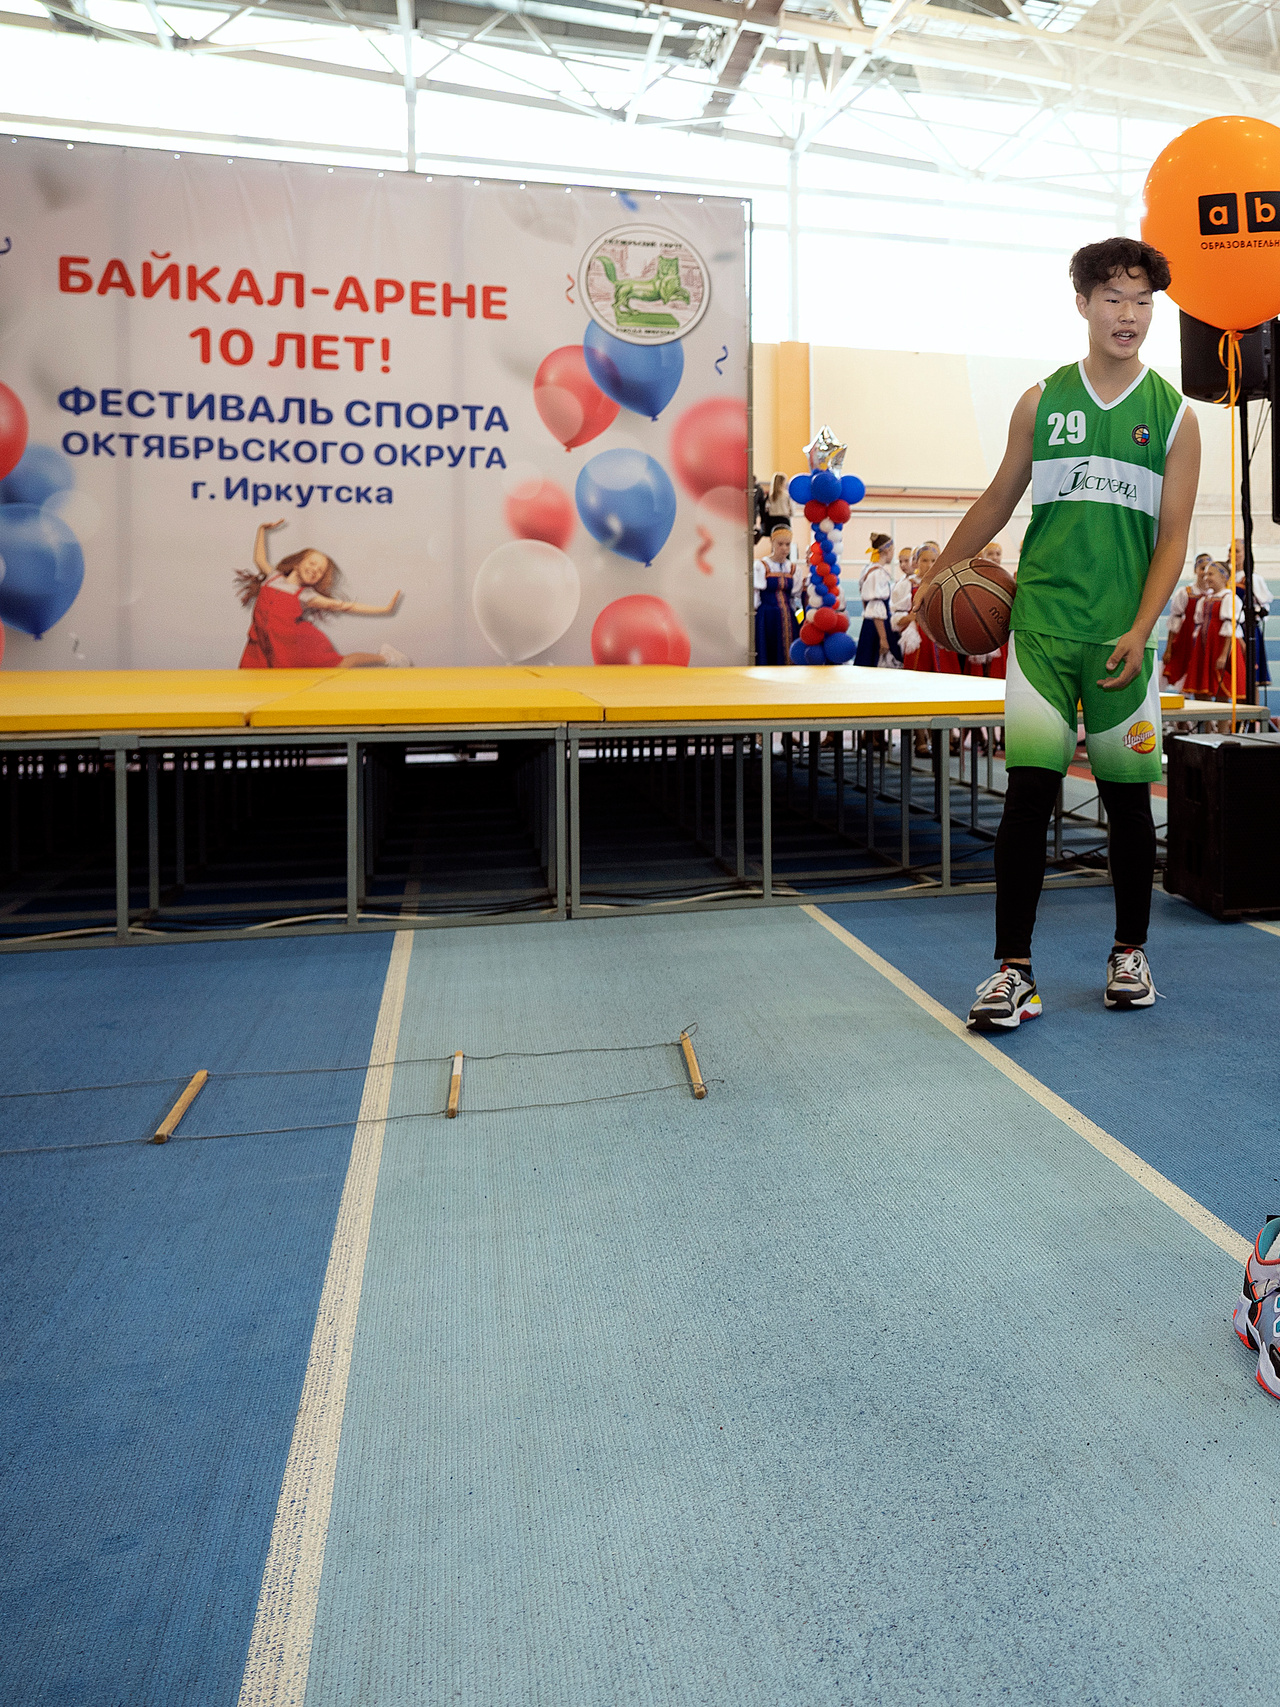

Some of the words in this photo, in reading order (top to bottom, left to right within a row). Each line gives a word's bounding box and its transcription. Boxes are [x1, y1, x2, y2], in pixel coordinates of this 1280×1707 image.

[59, 250, 507, 320] БАЙКАЛ-АРЕНЕ
[189, 326, 254, 366] 10
[268, 332, 390, 374] ЛЕТ!
[58, 386, 334, 425] ФЕСТИВАЛЬ
[344, 399, 509, 432] СПОРТА
[1047, 410, 1086, 446] 29
[62, 430, 364, 466] ОКТЯБРЬСКОГО
[374, 443, 507, 469] ОКРУГА
[191, 481, 216, 499] г.
[225, 476, 393, 508] Иркутска
